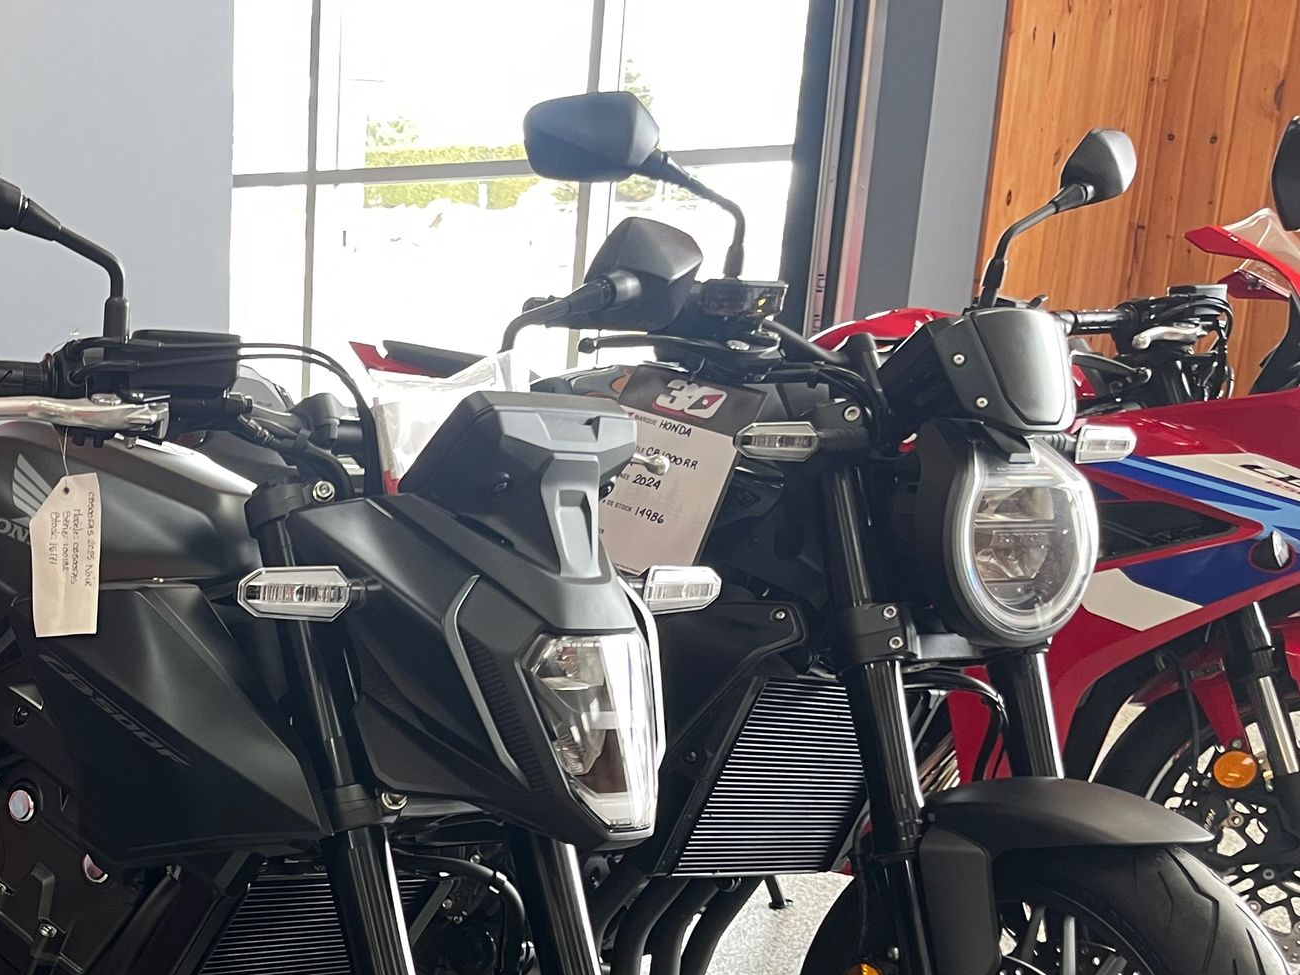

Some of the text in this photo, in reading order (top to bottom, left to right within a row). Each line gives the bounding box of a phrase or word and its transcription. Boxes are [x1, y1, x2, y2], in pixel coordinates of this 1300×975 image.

[658, 419, 693, 437] HONDA
[632, 473, 662, 490] 2024
[614, 502, 632, 512] STOCK
[633, 506, 666, 525] 14986
[86, 539, 95, 560] 2025
